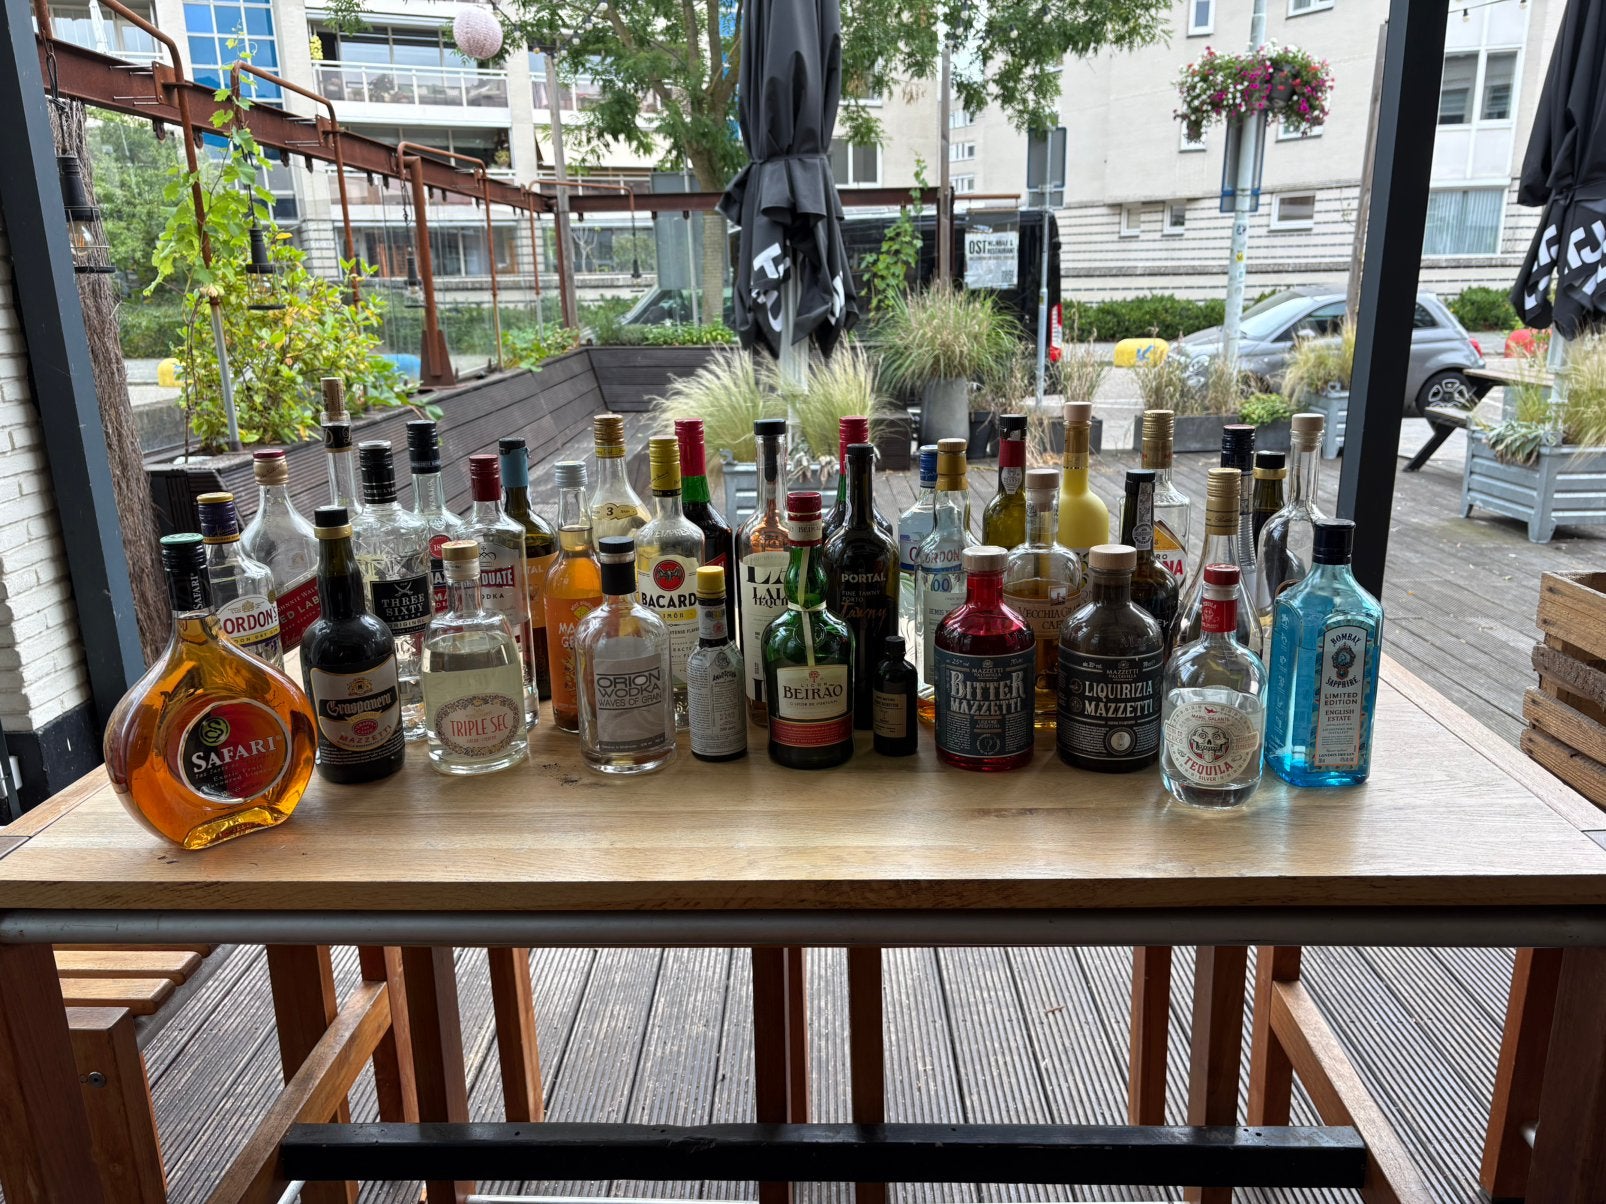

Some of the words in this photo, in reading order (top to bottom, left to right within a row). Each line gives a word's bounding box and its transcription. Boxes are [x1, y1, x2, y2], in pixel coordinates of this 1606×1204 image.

[969, 240, 986, 255] OST
[606, 506, 614, 516] 3
[481, 571, 514, 585] DUATE
[841, 572, 886, 584] PORTAL
[190, 575, 204, 610] SAFARI
[381, 593, 425, 607] THREE
[641, 592, 697, 609] BACARD
[386, 603, 424, 617] SIXTY
[223, 605, 278, 634] ORDON'S
[1330, 632, 1362, 646] BOMBAY
[597, 670, 661, 689] ORION
[950, 671, 1026, 701] BITTER
[598, 683, 661, 698] WODKA
[1085, 680, 1153, 702] LIQUIRIZIA
[598, 698, 626, 707] WAVES
[629, 698, 639, 706] OF
[642, 692, 662, 704] GRAIN
[950, 698, 1021, 715] MAZZETTI
[1085, 699, 1153, 718] MAZZETTI
[450, 718, 488, 737] TRIPLE
[490, 713, 509, 733] SEC
[338, 725, 392, 743] MAZZETTI
[191, 736, 277, 773] SAFARI
[1184, 755, 1234, 776] TEQUILA
